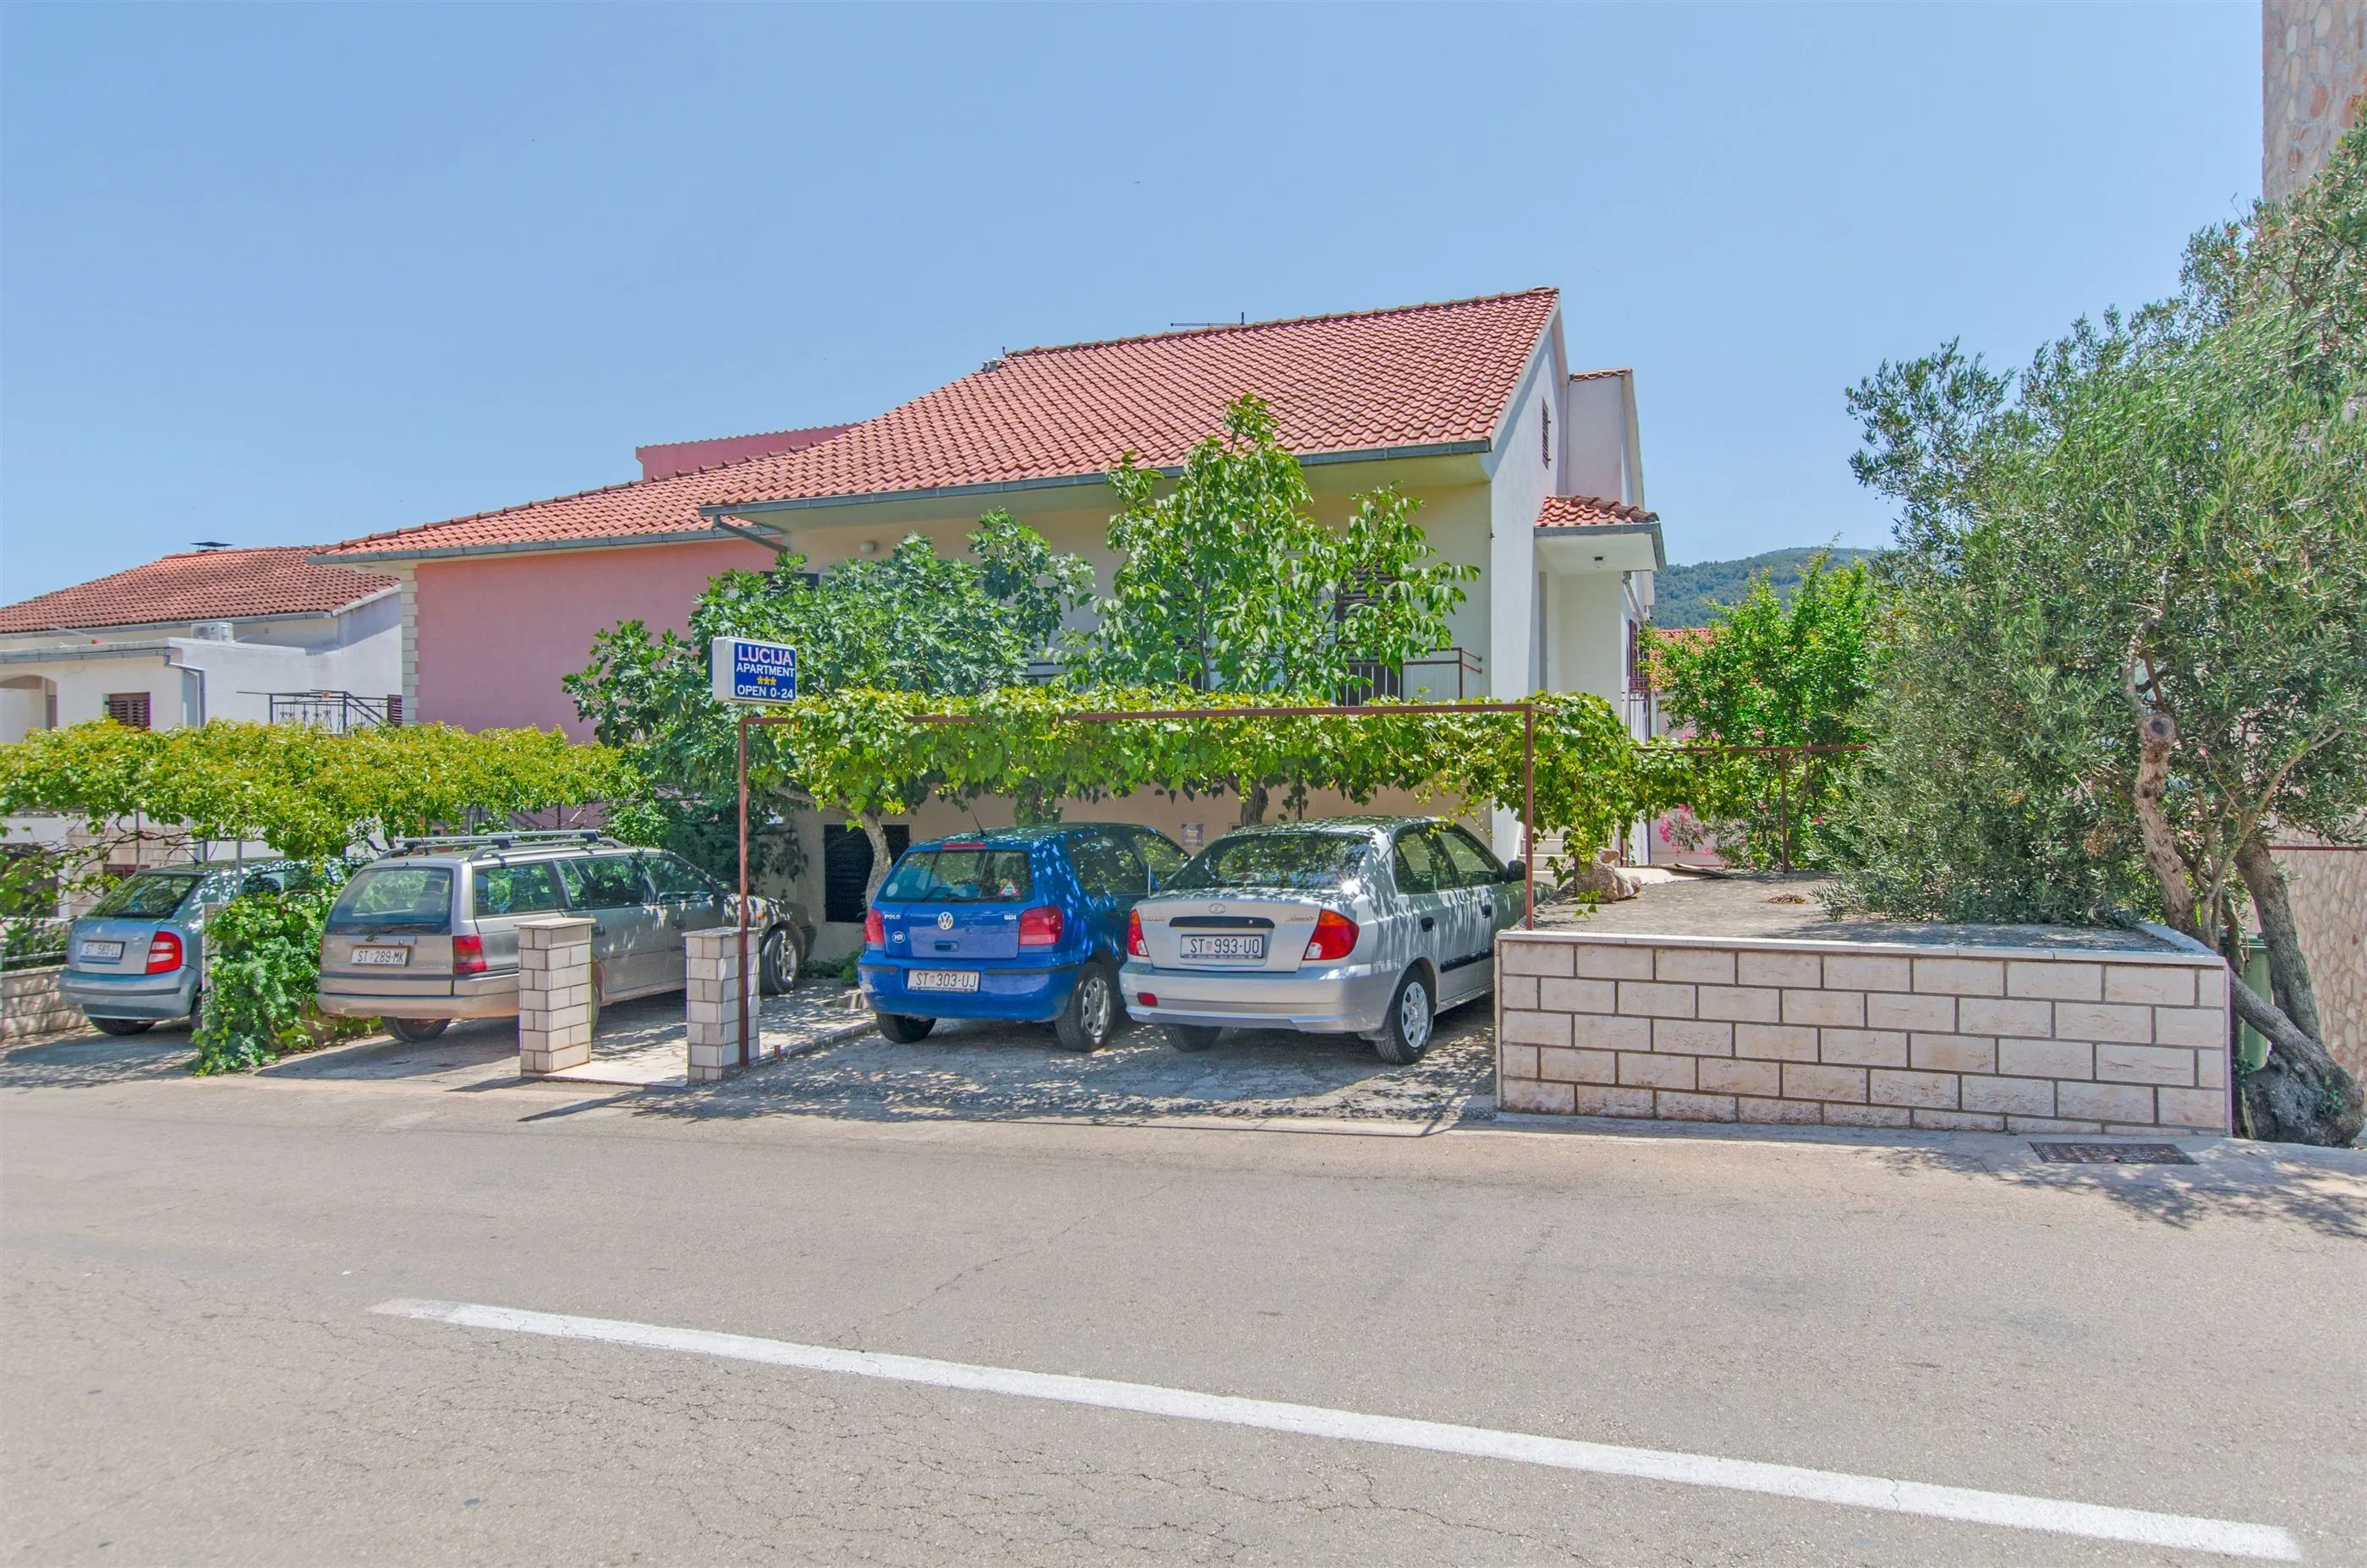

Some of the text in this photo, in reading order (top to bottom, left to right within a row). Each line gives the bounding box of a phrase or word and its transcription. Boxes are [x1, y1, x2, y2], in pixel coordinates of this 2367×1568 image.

[738, 645, 792, 666] LUCIJA
[736, 662, 795, 677] APARTMENT
[737, 684, 794, 699] OPEN 0-24
[85, 944, 95, 955] ST
[1190, 939, 1205, 953] ST
[358, 951, 405, 963] ST 289-MK
[916, 973, 977, 988] ST 303-UJ
